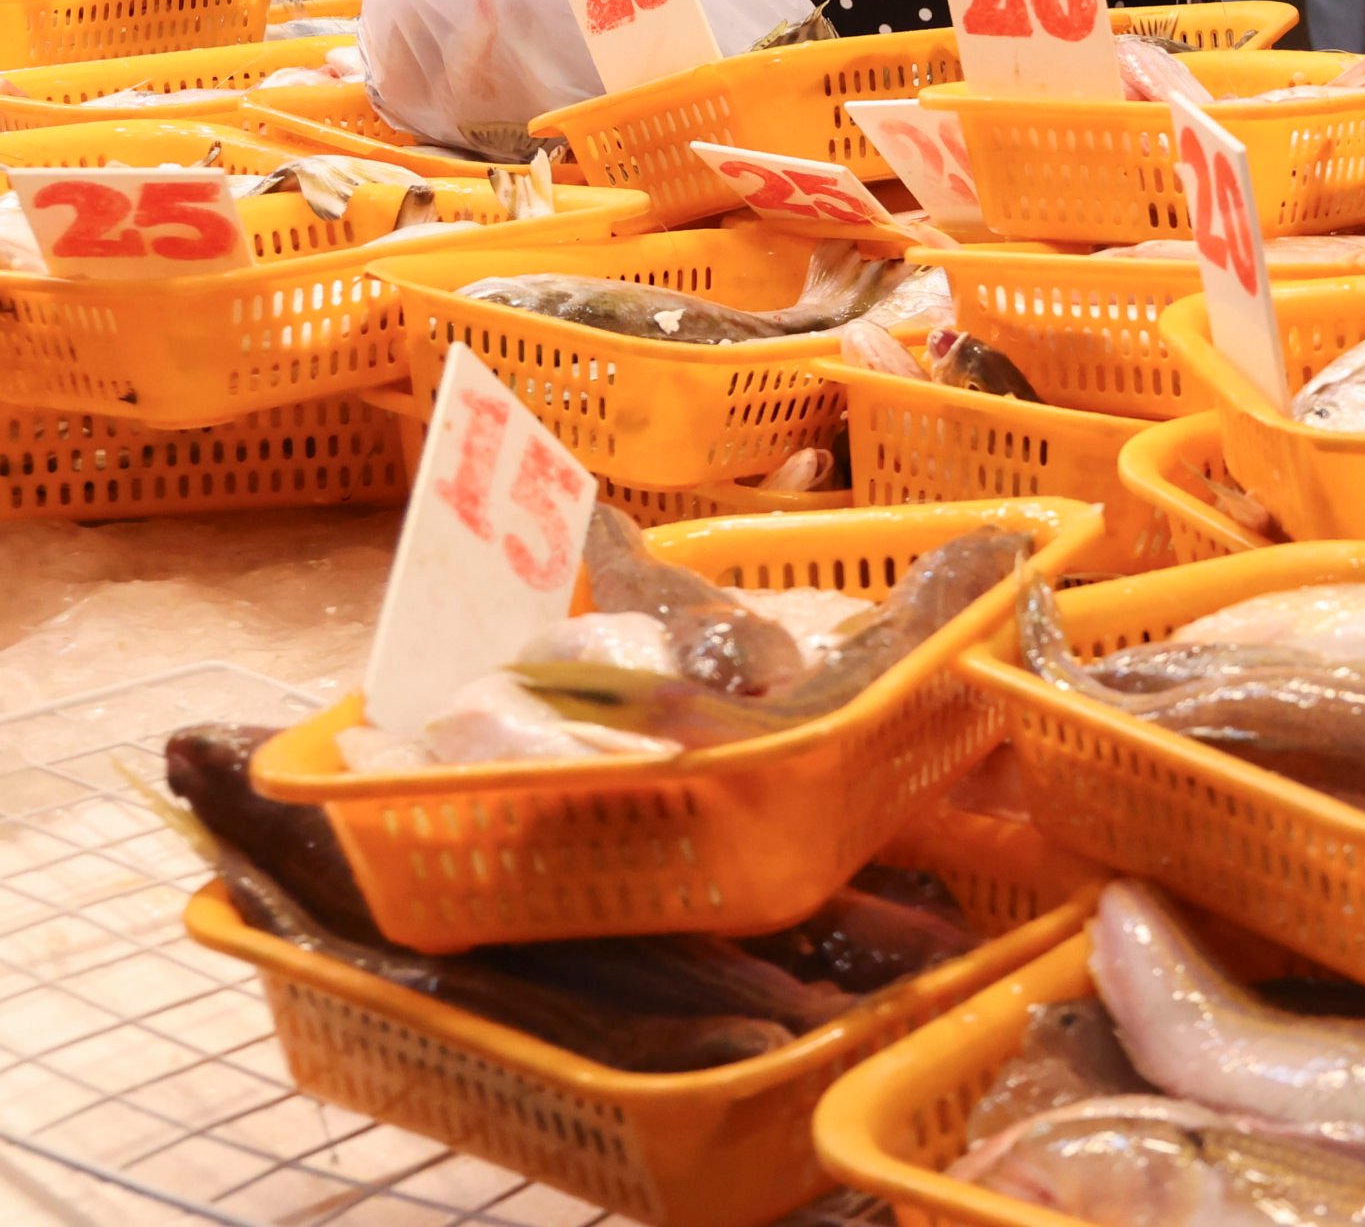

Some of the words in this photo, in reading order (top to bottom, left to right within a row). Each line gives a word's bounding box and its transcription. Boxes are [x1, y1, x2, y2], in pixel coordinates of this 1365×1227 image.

[33, 180, 239, 261] 25
[719, 161, 873, 224] 25
[1180, 126, 1258, 297] 20
[434, 389, 586, 594] 15
